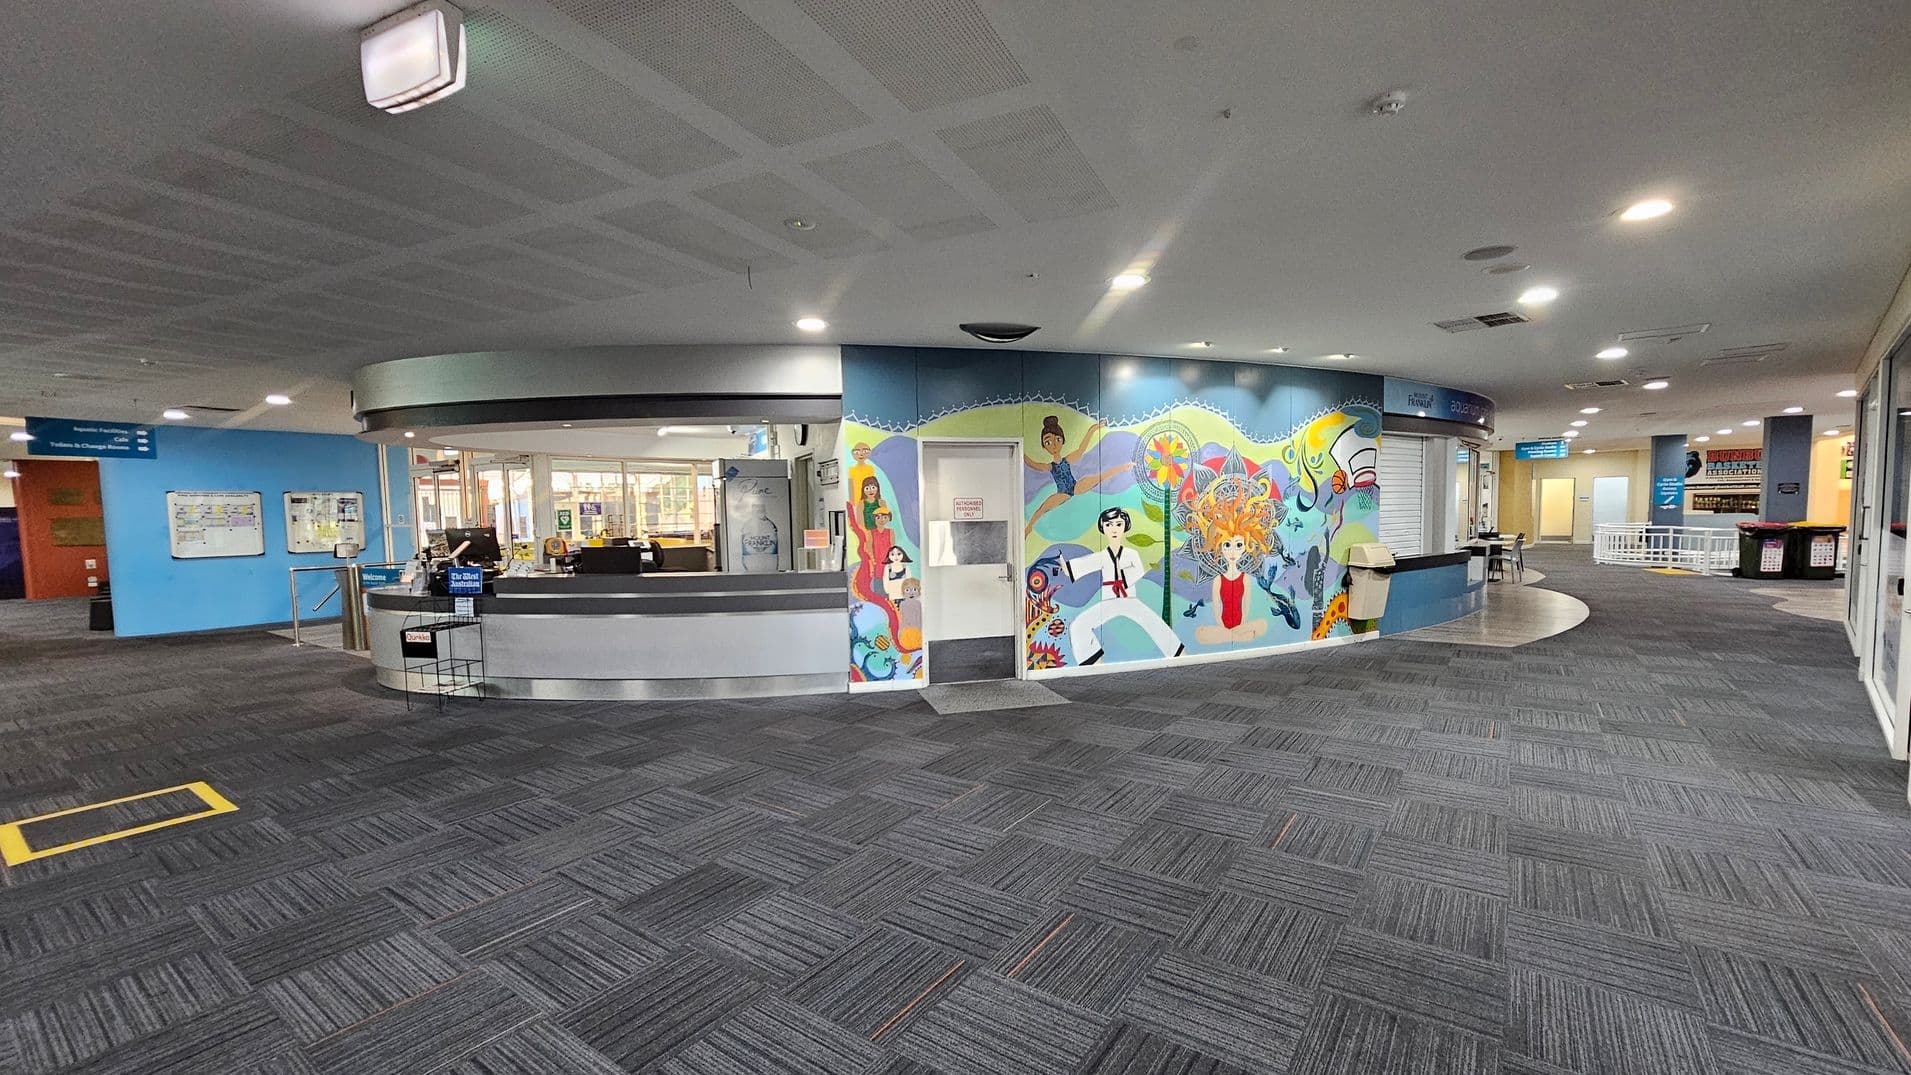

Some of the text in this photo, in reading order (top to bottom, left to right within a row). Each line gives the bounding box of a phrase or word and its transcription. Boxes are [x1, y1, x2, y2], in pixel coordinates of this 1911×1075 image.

[362, 572, 386, 581] Welcome
[450, 572, 479, 580] The West
[450, 580, 480, 588] Australian
